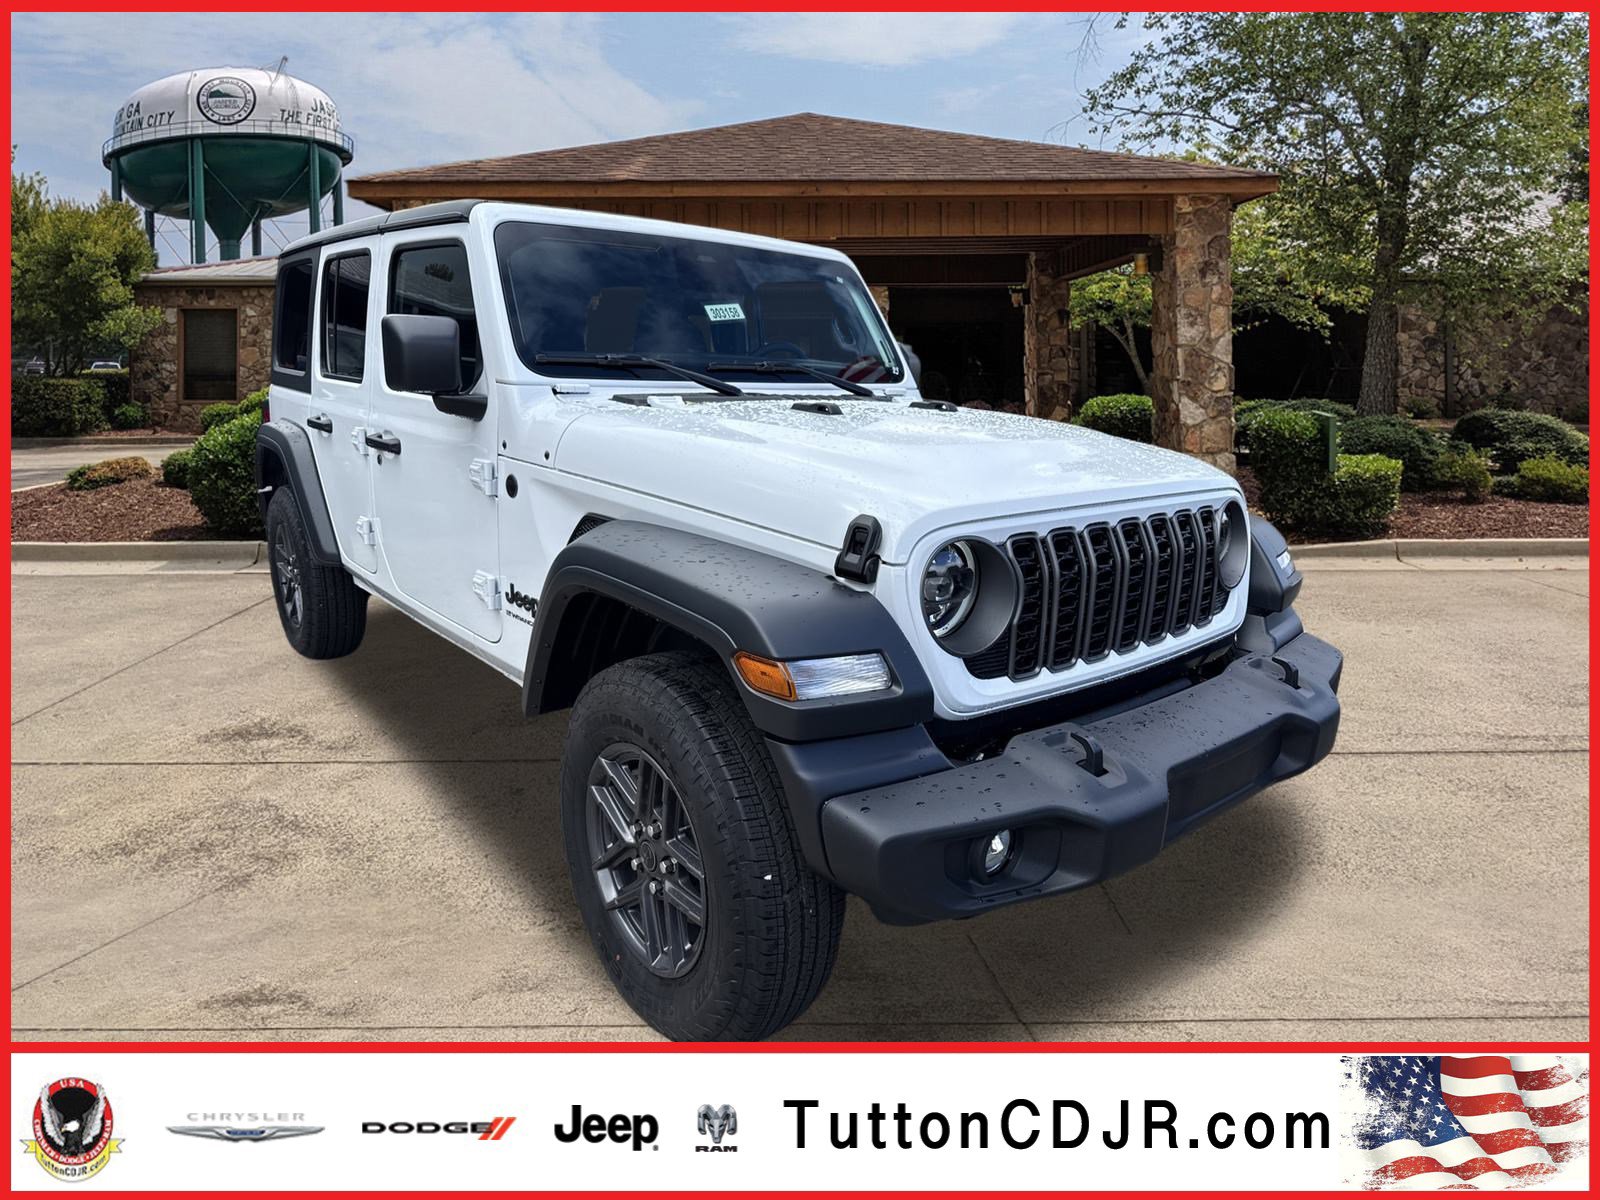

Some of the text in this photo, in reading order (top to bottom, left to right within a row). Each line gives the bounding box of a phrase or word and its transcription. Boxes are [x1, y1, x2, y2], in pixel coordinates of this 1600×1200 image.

[126, 101, 141, 119] GA
[147, 110, 175, 127] CITY
[280, 109, 302, 124] THE
[306, 112, 332, 129] FIRST
[710, 307, 741, 319] 303158
